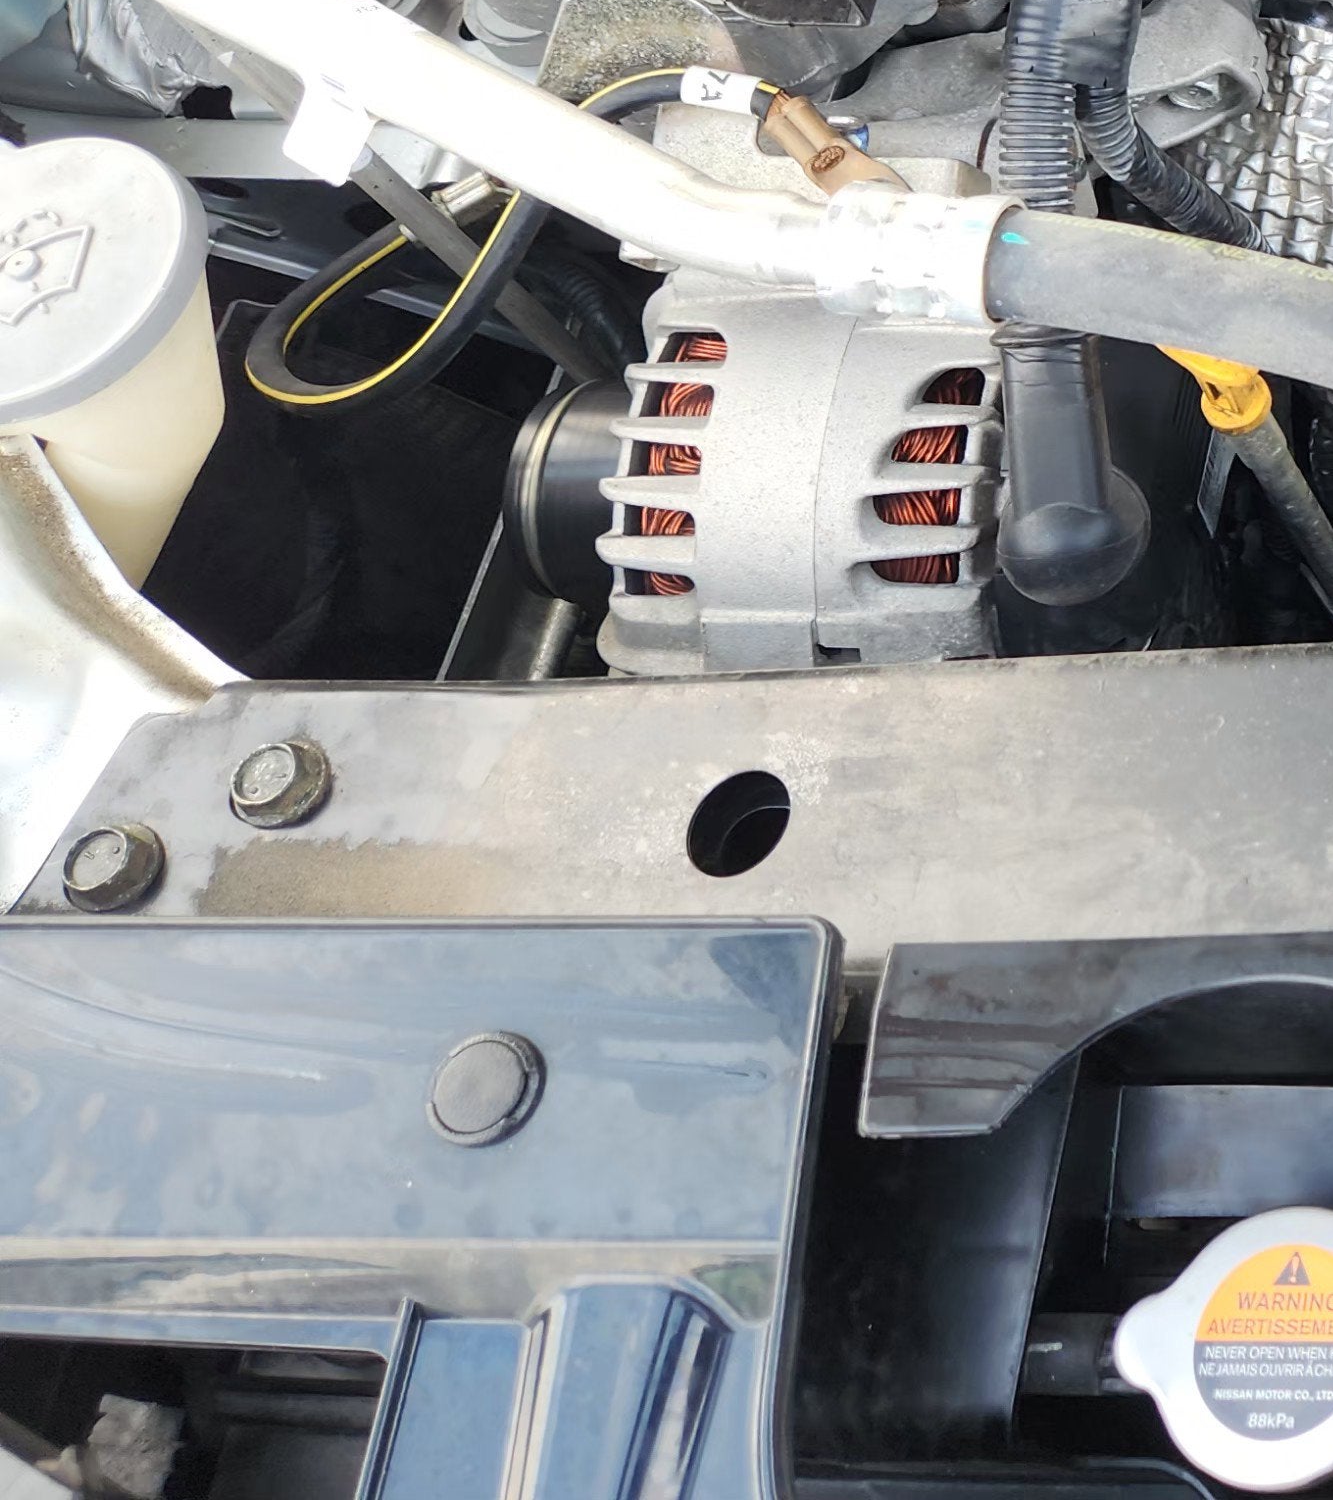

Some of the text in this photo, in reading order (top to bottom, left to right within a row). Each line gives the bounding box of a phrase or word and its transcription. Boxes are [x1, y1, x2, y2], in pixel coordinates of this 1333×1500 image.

[1205, 1346, 1247, 1360] NEVER
[1249, 1346, 1285, 1360] OPEN
[1287, 1347, 1327, 1360] WHEN
[1199, 1362, 1216, 1376] NE
[1215, 1363, 1258, 1377] JAMAIS
[1259, 1363, 1304, 1377] OUVRIR
[1214, 1388, 1253, 1401] NISSAN
[1255, 1389, 1292, 1401] MOTOR
[1248, 1412, 1295, 1429] 88kPa
